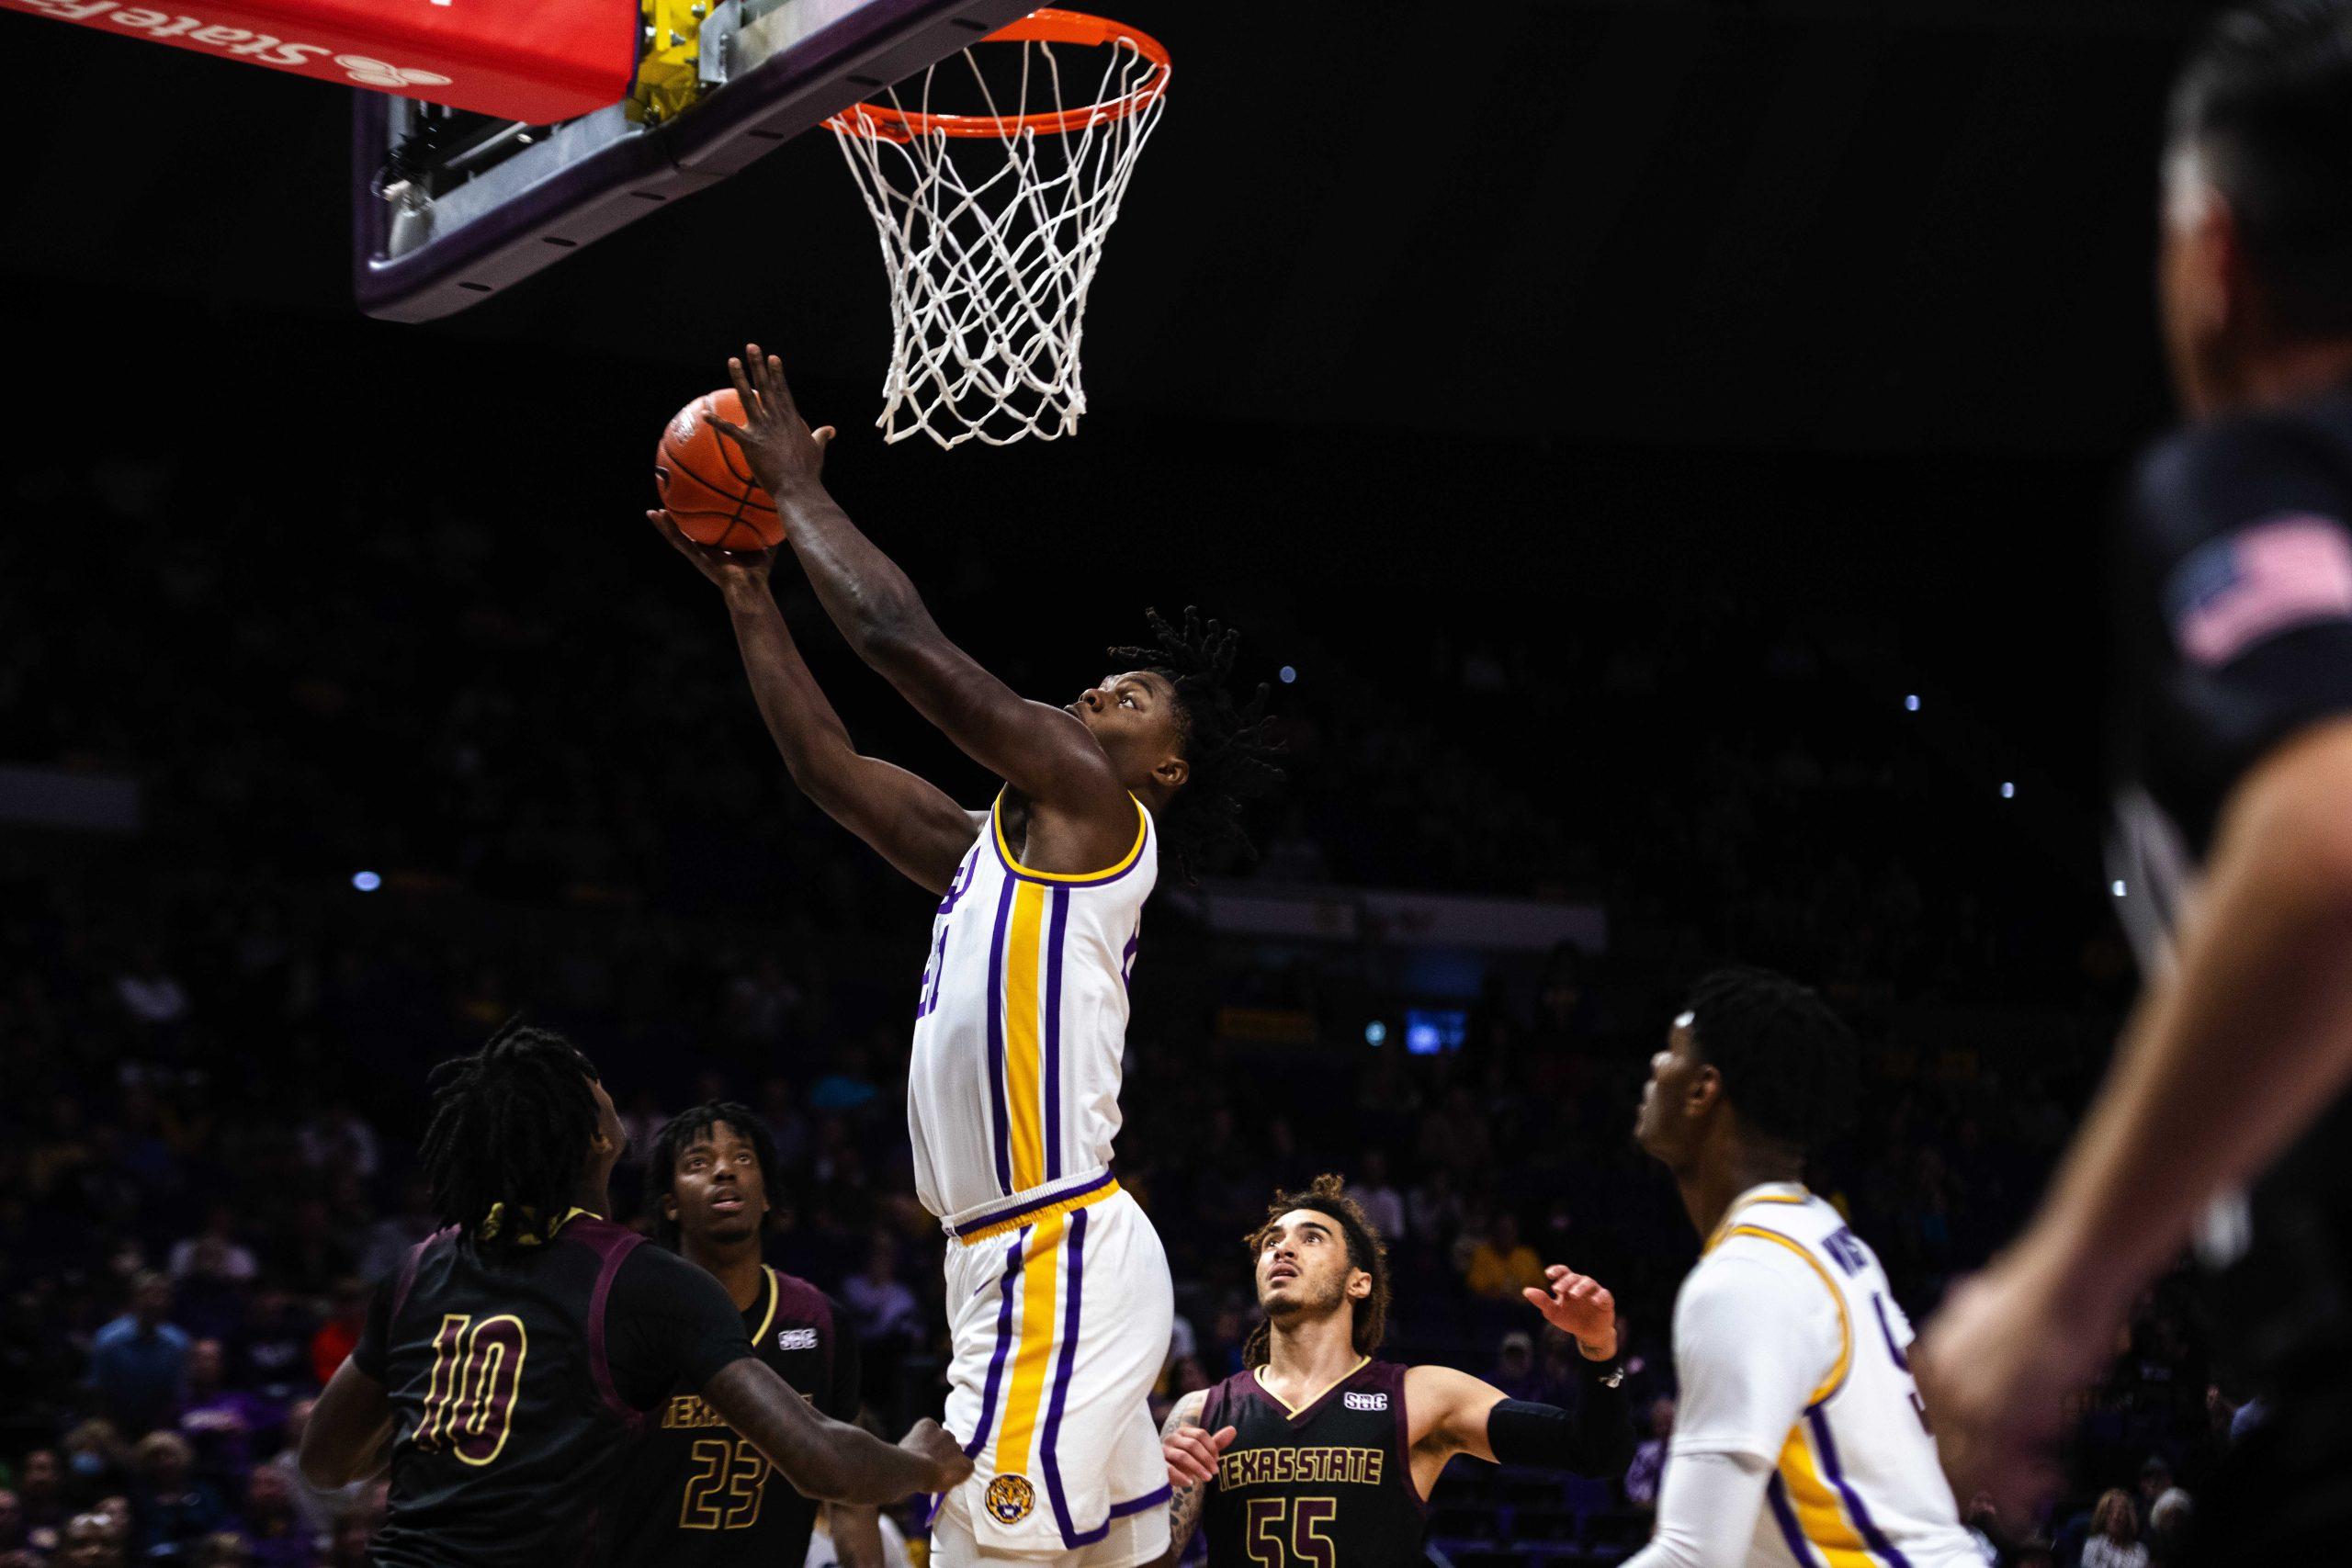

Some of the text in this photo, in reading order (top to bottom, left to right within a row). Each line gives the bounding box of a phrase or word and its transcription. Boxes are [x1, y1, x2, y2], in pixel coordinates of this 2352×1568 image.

[412, 1314, 527, 1466] 10
[679, 1439, 773, 1530] 23
[1247, 1496, 1337, 1568] 55
